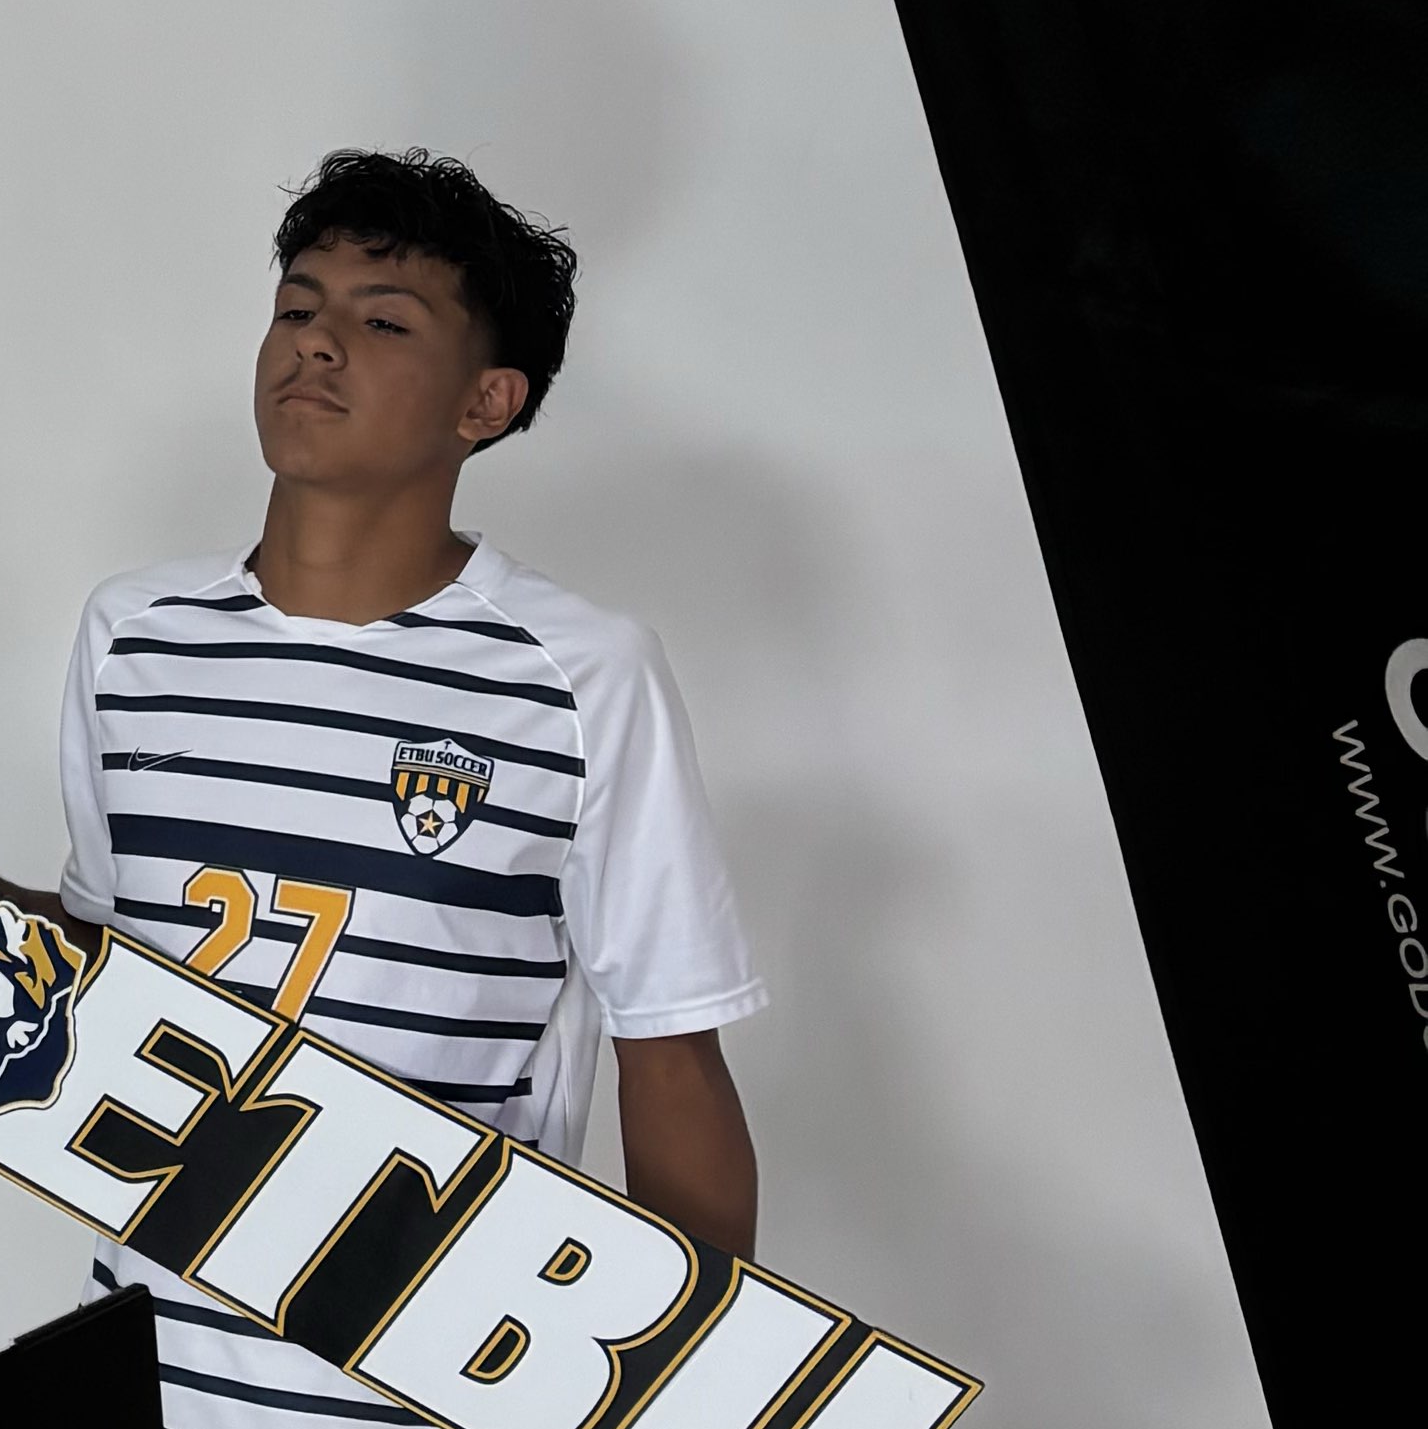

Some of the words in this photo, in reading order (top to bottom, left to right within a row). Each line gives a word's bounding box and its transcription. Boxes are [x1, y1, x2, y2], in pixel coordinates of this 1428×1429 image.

[398, 746, 435, 763] ETBU
[436, 750, 488, 777] SOCCER
[182, 864, 355, 1022] 27
[1332, 719, 1428, 1053] WWW.GOD
